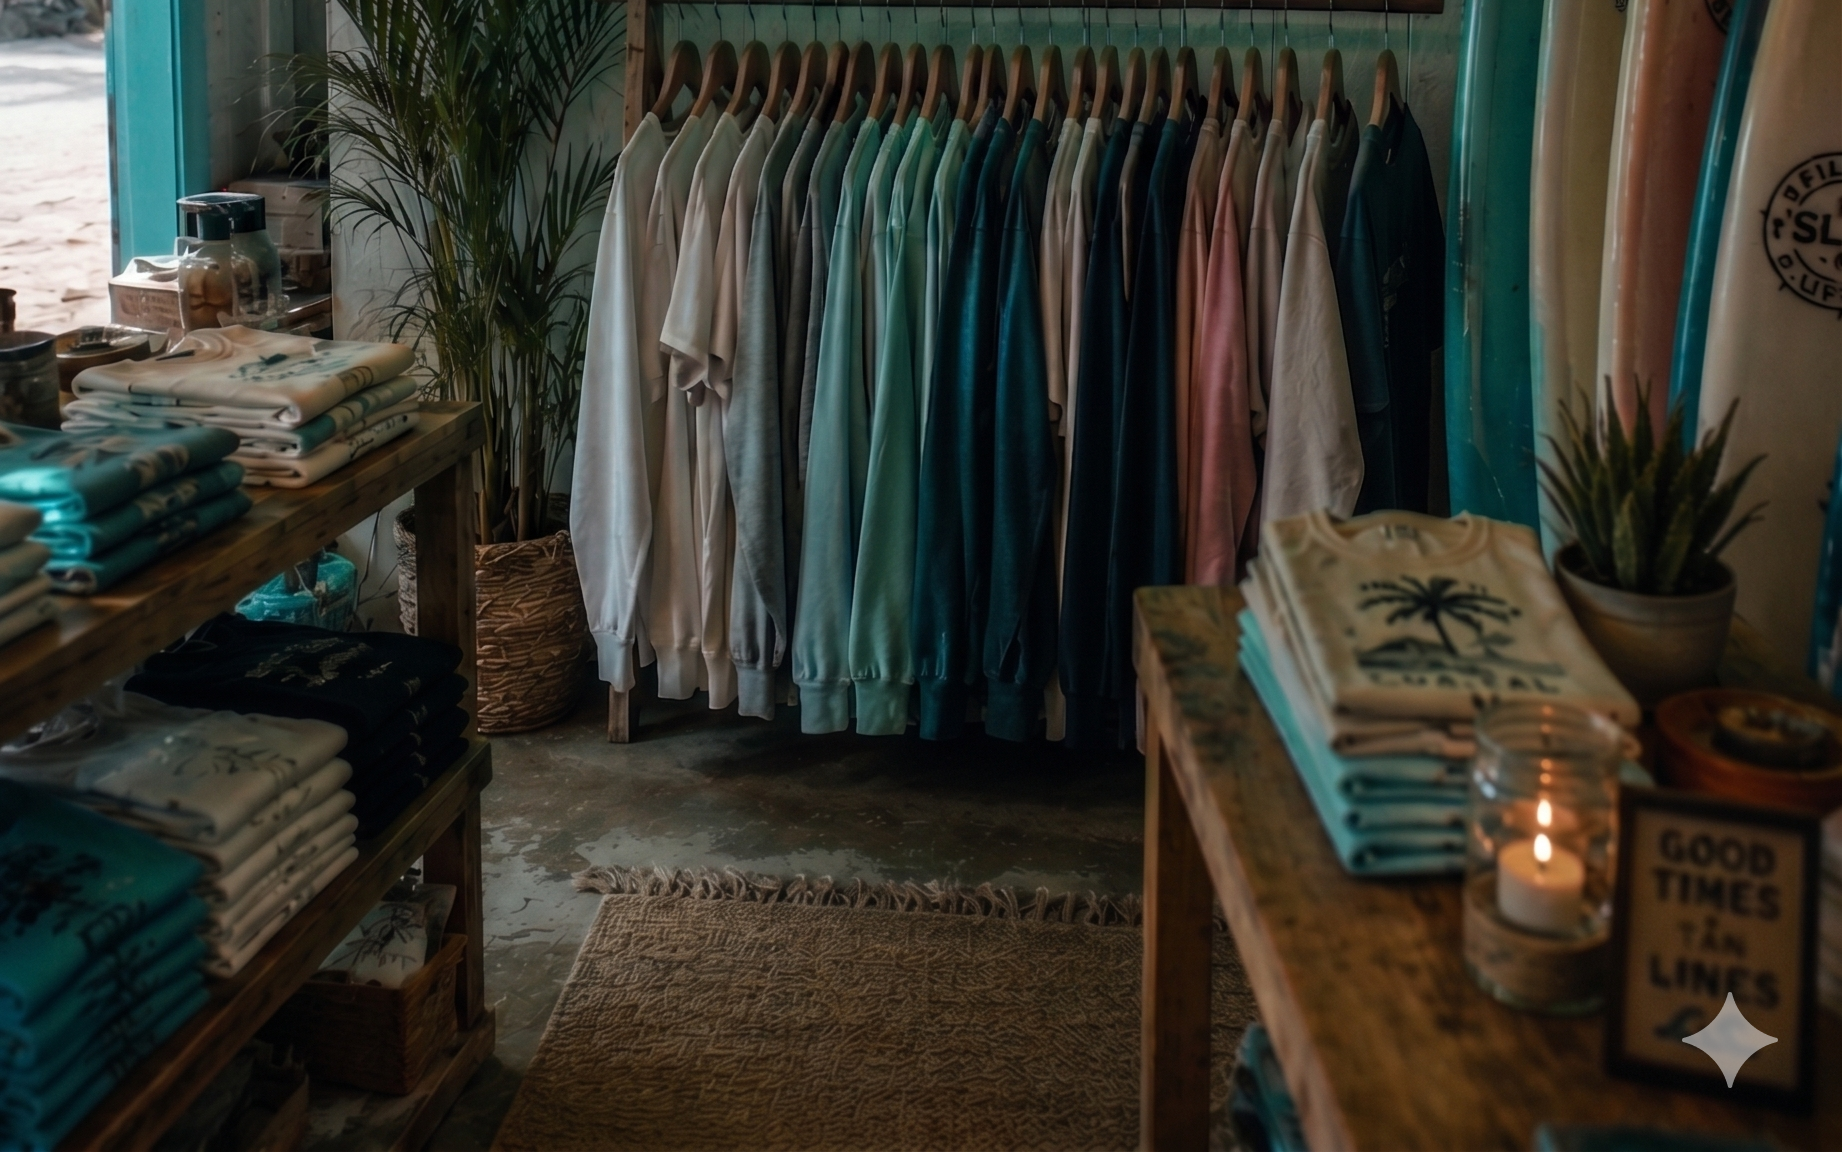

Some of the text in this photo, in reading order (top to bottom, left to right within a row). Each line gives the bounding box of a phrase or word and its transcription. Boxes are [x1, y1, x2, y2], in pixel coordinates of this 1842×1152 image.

[1658, 827, 1777, 877] GOOD
[1652, 866, 1782, 922] TIMES
[1648, 952, 1781, 1011] LINES
